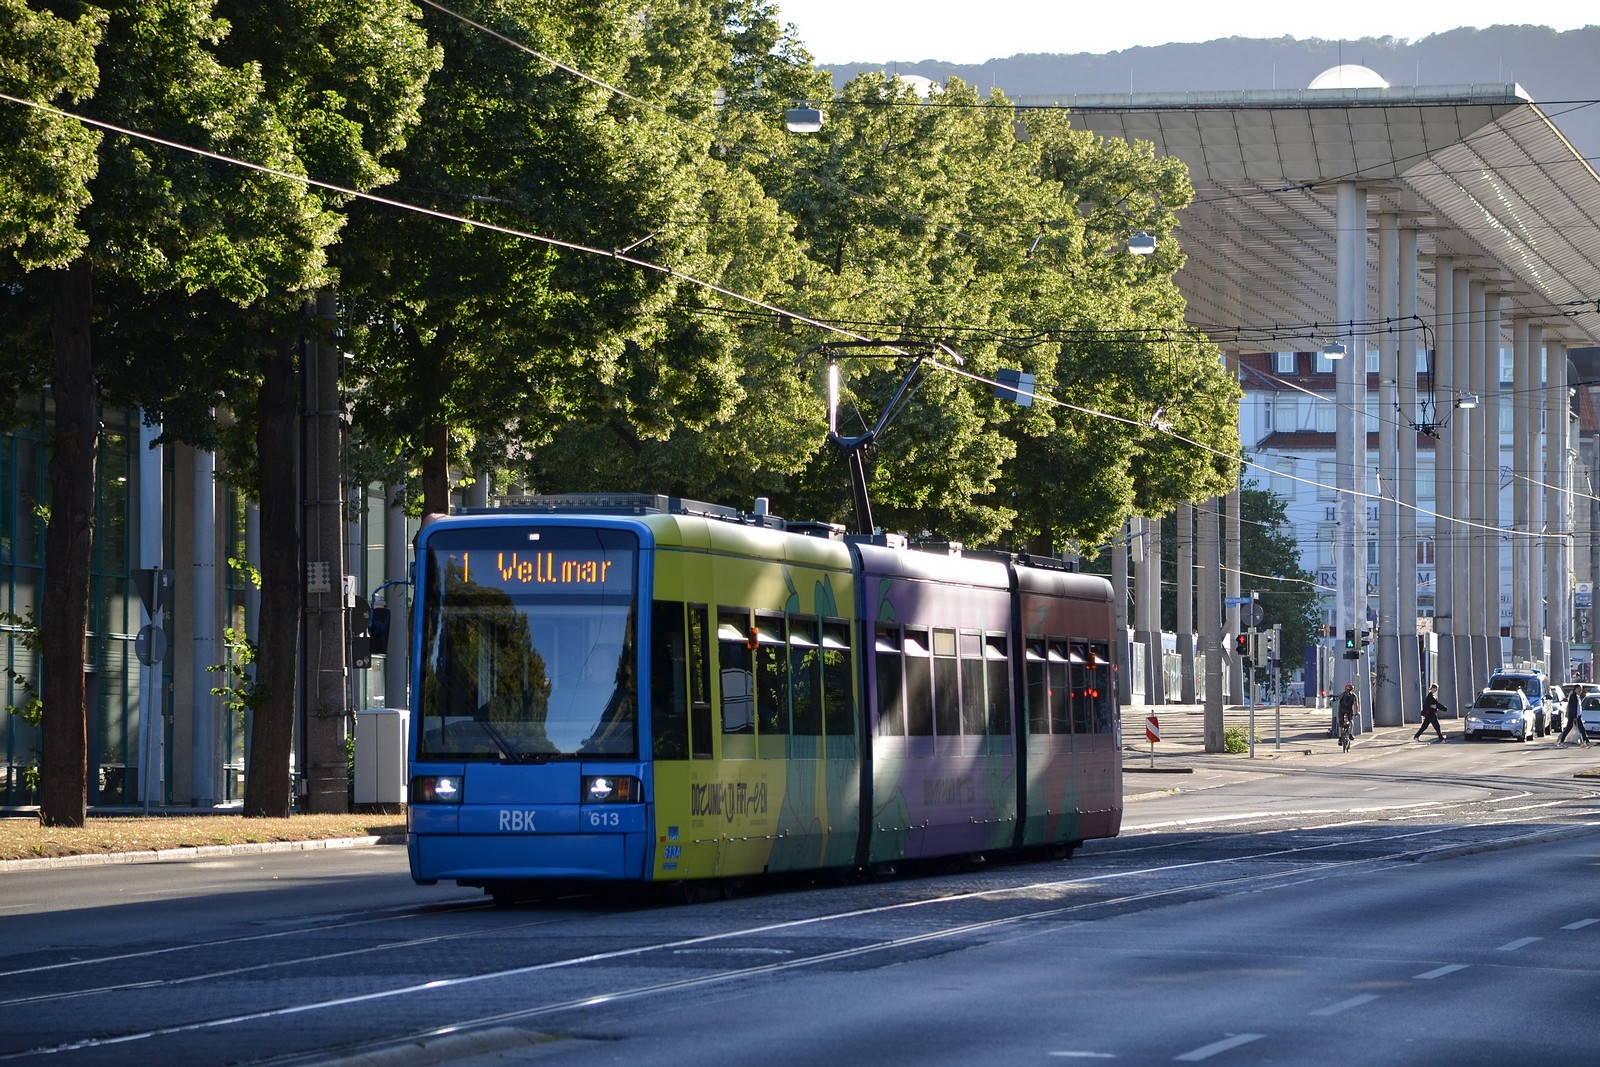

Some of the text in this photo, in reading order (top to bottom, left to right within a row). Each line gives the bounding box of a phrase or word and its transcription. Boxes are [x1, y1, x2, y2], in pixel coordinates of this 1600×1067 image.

[1325, 506, 1380, 521] HEL
[463, 552, 612, 583] 1 Vellmar
[499, 809, 536, 832] RBK
[590, 811, 620, 827] 613
[663, 845, 681, 859] 613A
